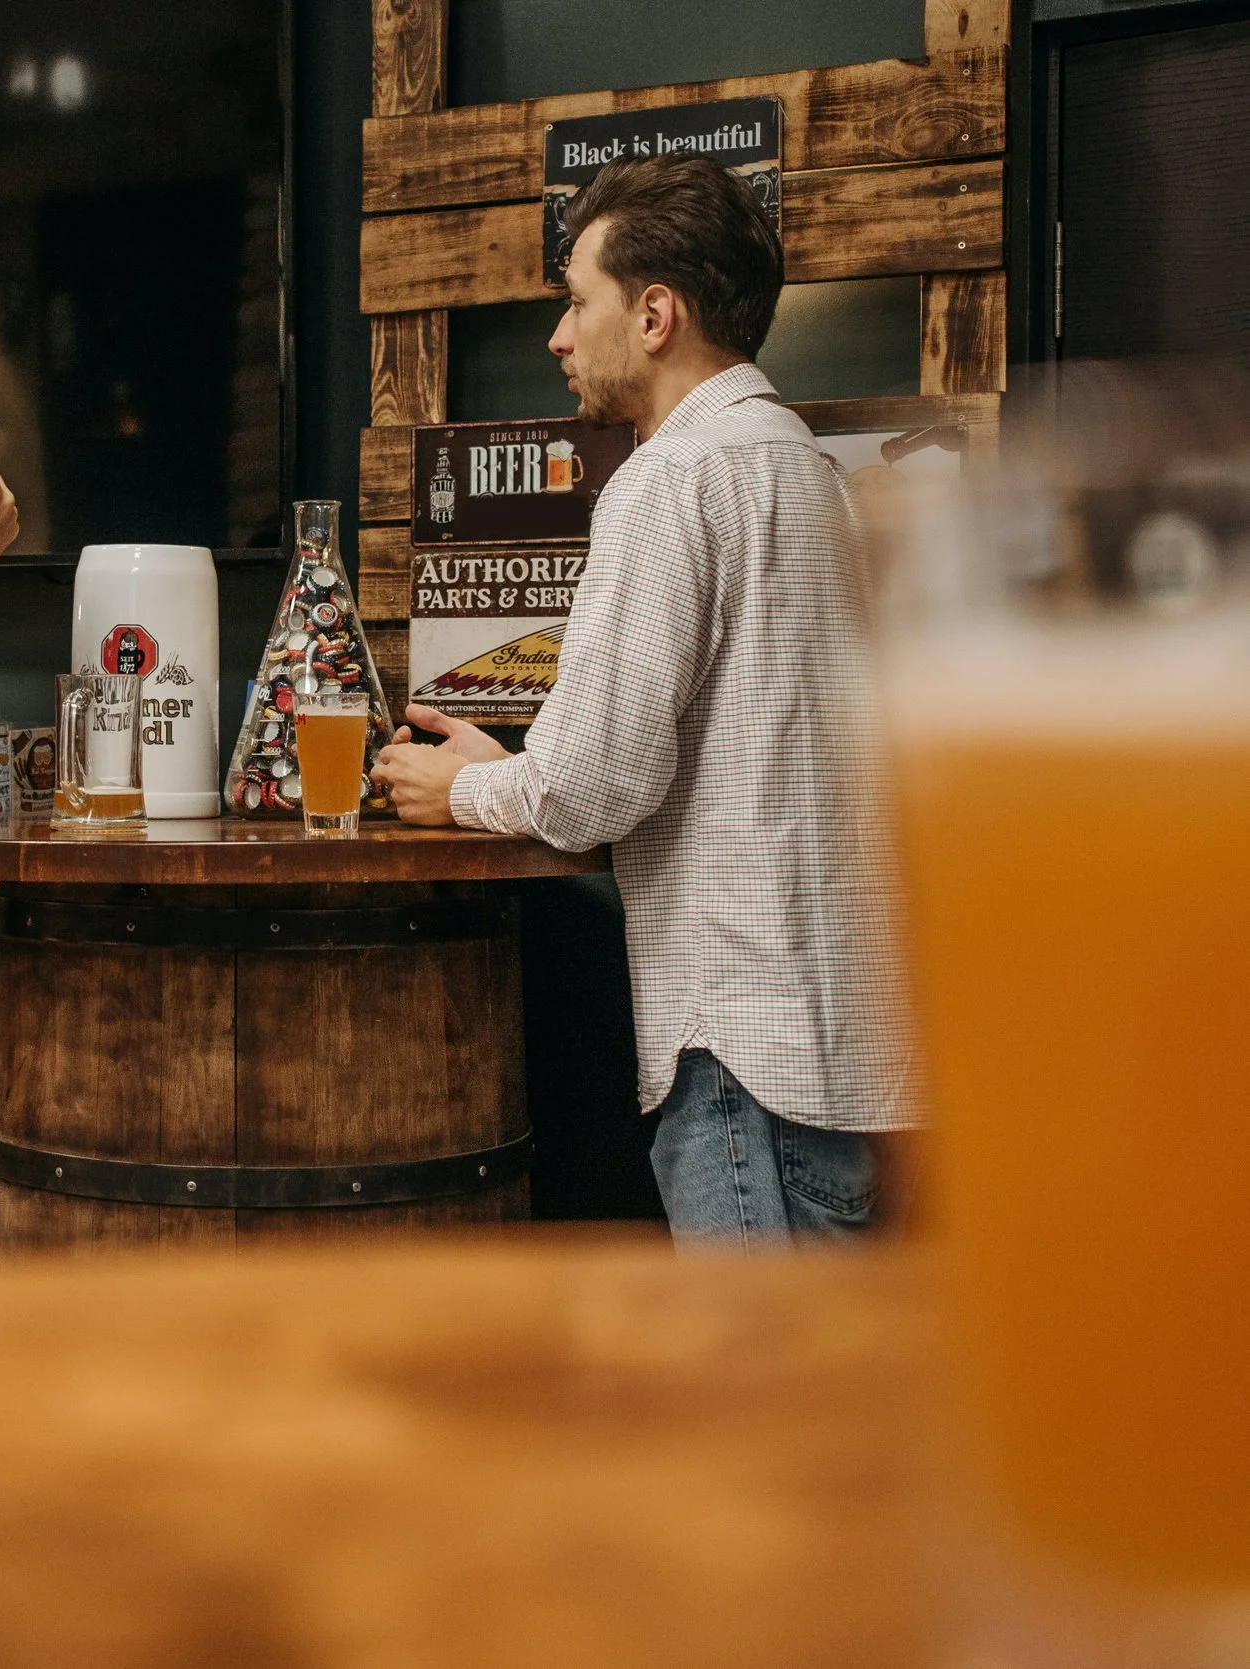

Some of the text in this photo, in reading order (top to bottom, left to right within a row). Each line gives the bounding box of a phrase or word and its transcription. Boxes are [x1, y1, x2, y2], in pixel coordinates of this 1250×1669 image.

[562, 122, 762, 168] Black is beautiful
[489, 430, 549, 442] SINCE 1810
[468, 443, 547, 497] BEER
[417, 557, 590, 584] AUTHORIZ
[417, 588, 491, 609] PARTS
[499, 588, 518, 608] &
[492, 645, 560, 665] India
[118, 662, 136, 675] 1872
